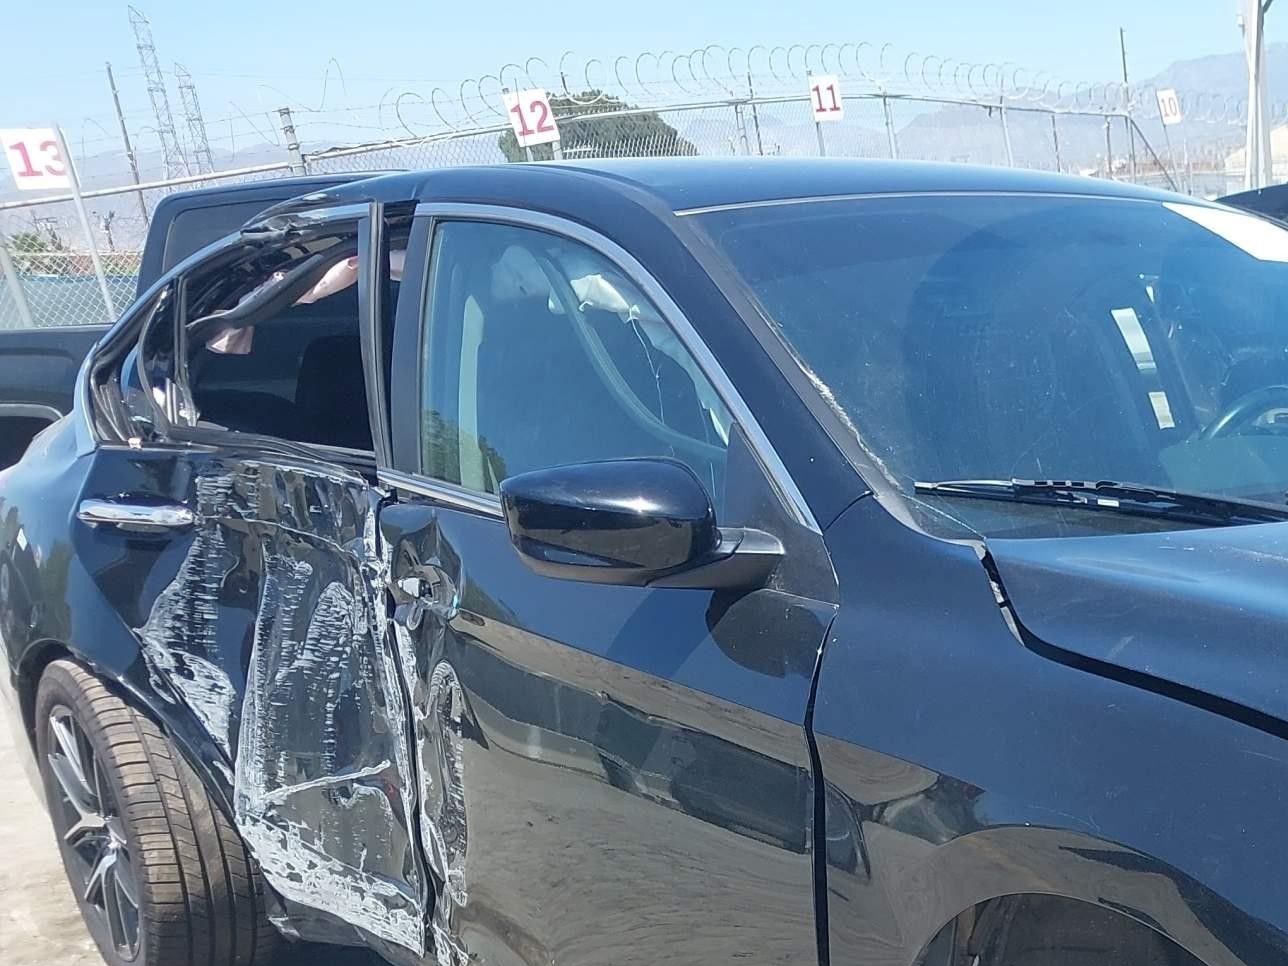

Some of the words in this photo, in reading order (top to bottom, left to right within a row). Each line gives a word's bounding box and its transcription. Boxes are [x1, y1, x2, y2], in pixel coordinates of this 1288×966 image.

[812, 83, 840, 113] 11
[1161, 97, 1178, 117] 10
[510, 101, 554, 136] 12
[9, 141, 67, 176] 13
